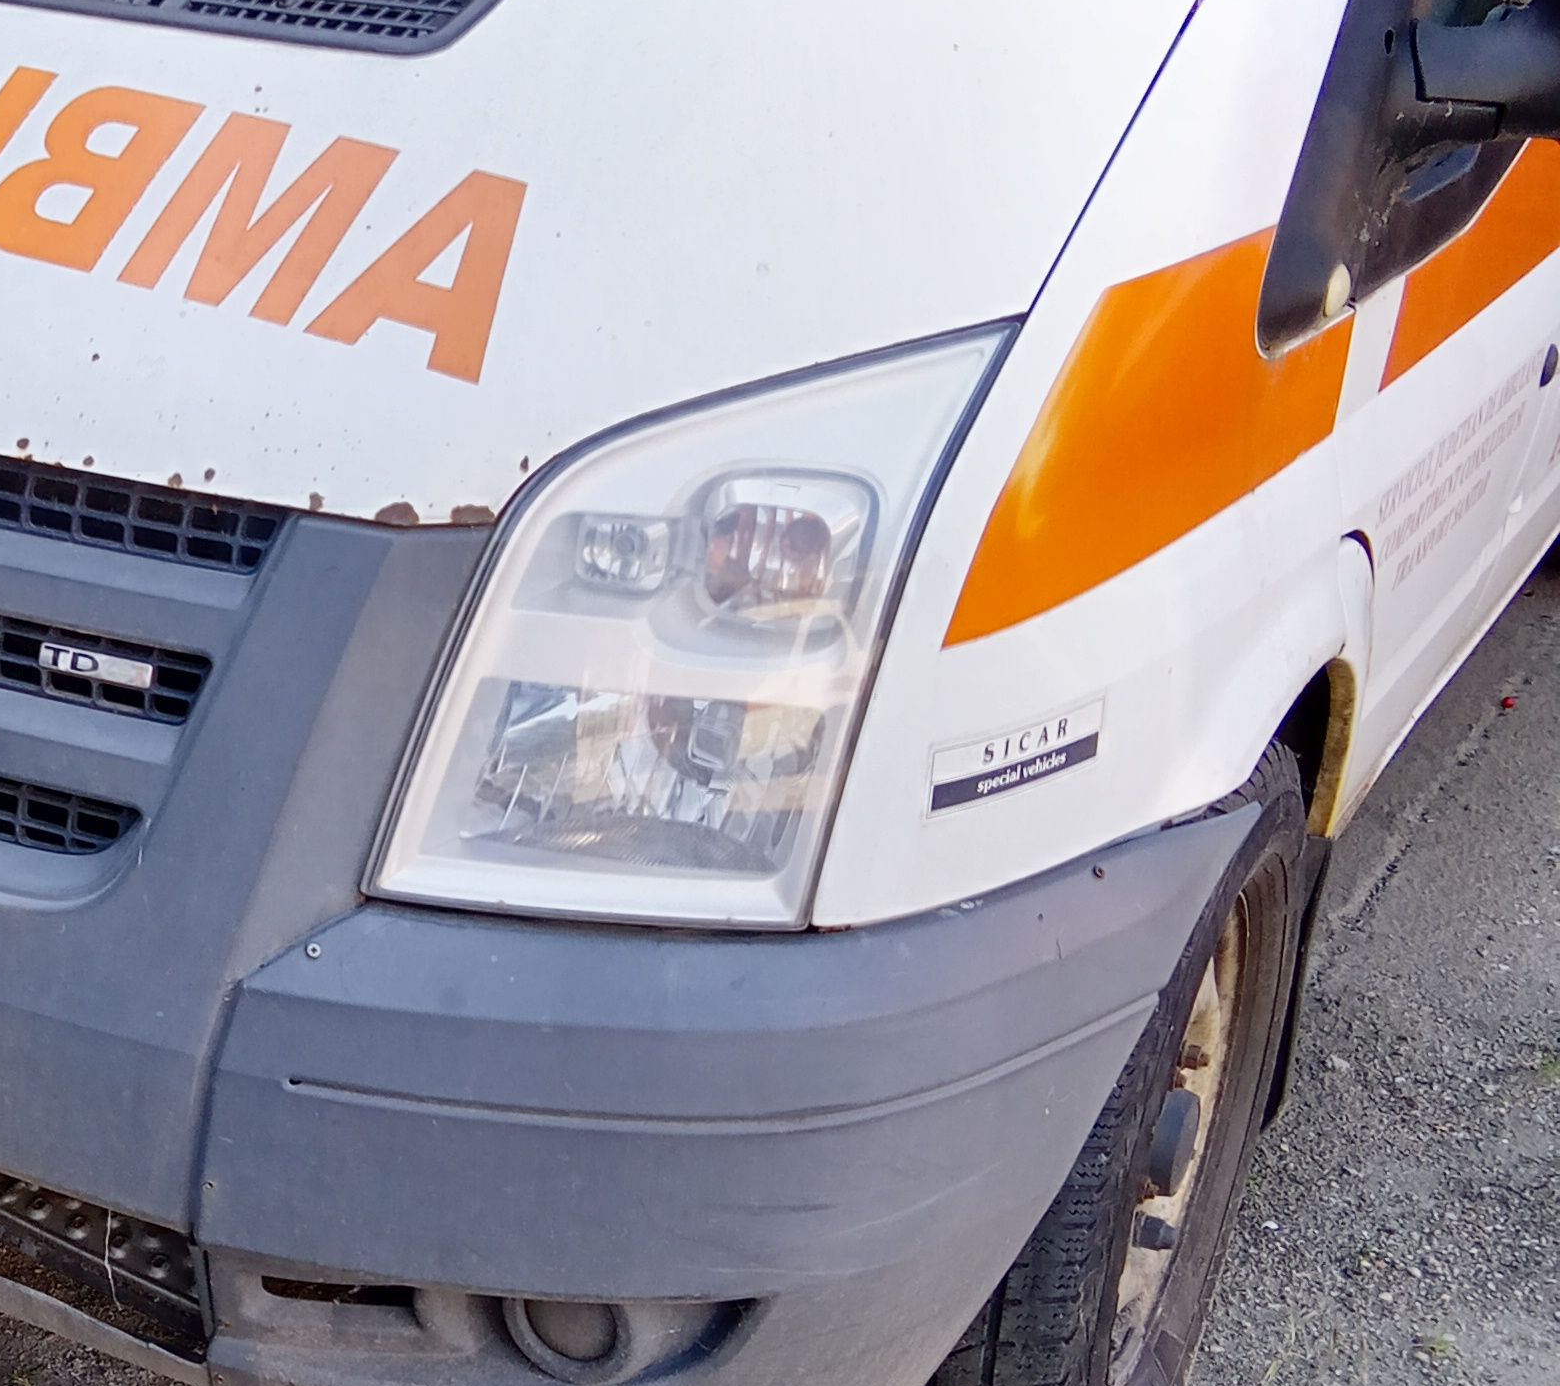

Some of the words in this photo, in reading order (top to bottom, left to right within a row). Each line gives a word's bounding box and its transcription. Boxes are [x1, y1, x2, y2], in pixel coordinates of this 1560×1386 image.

[983, 717, 1069, 765] SICAR
[976, 765, 1021, 795] special
[1022, 751, 1067, 779] vehicles
